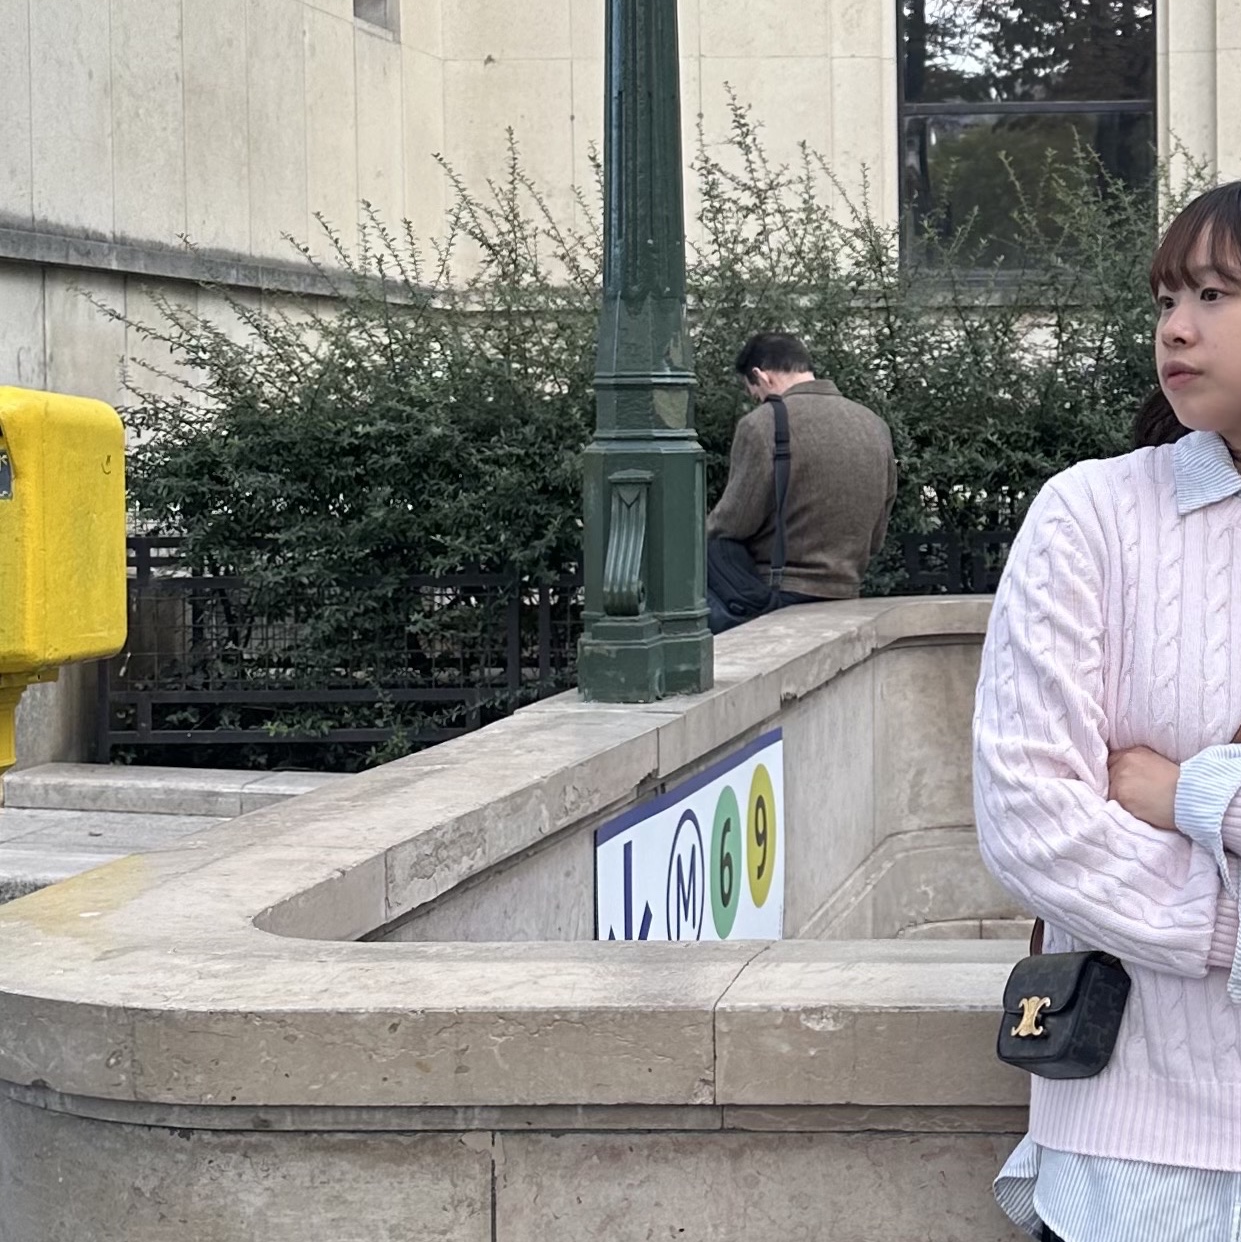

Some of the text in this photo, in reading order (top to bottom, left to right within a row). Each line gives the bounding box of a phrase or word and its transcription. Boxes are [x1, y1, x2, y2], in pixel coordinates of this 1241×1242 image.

[676, 794, 768, 940] M 6 9
